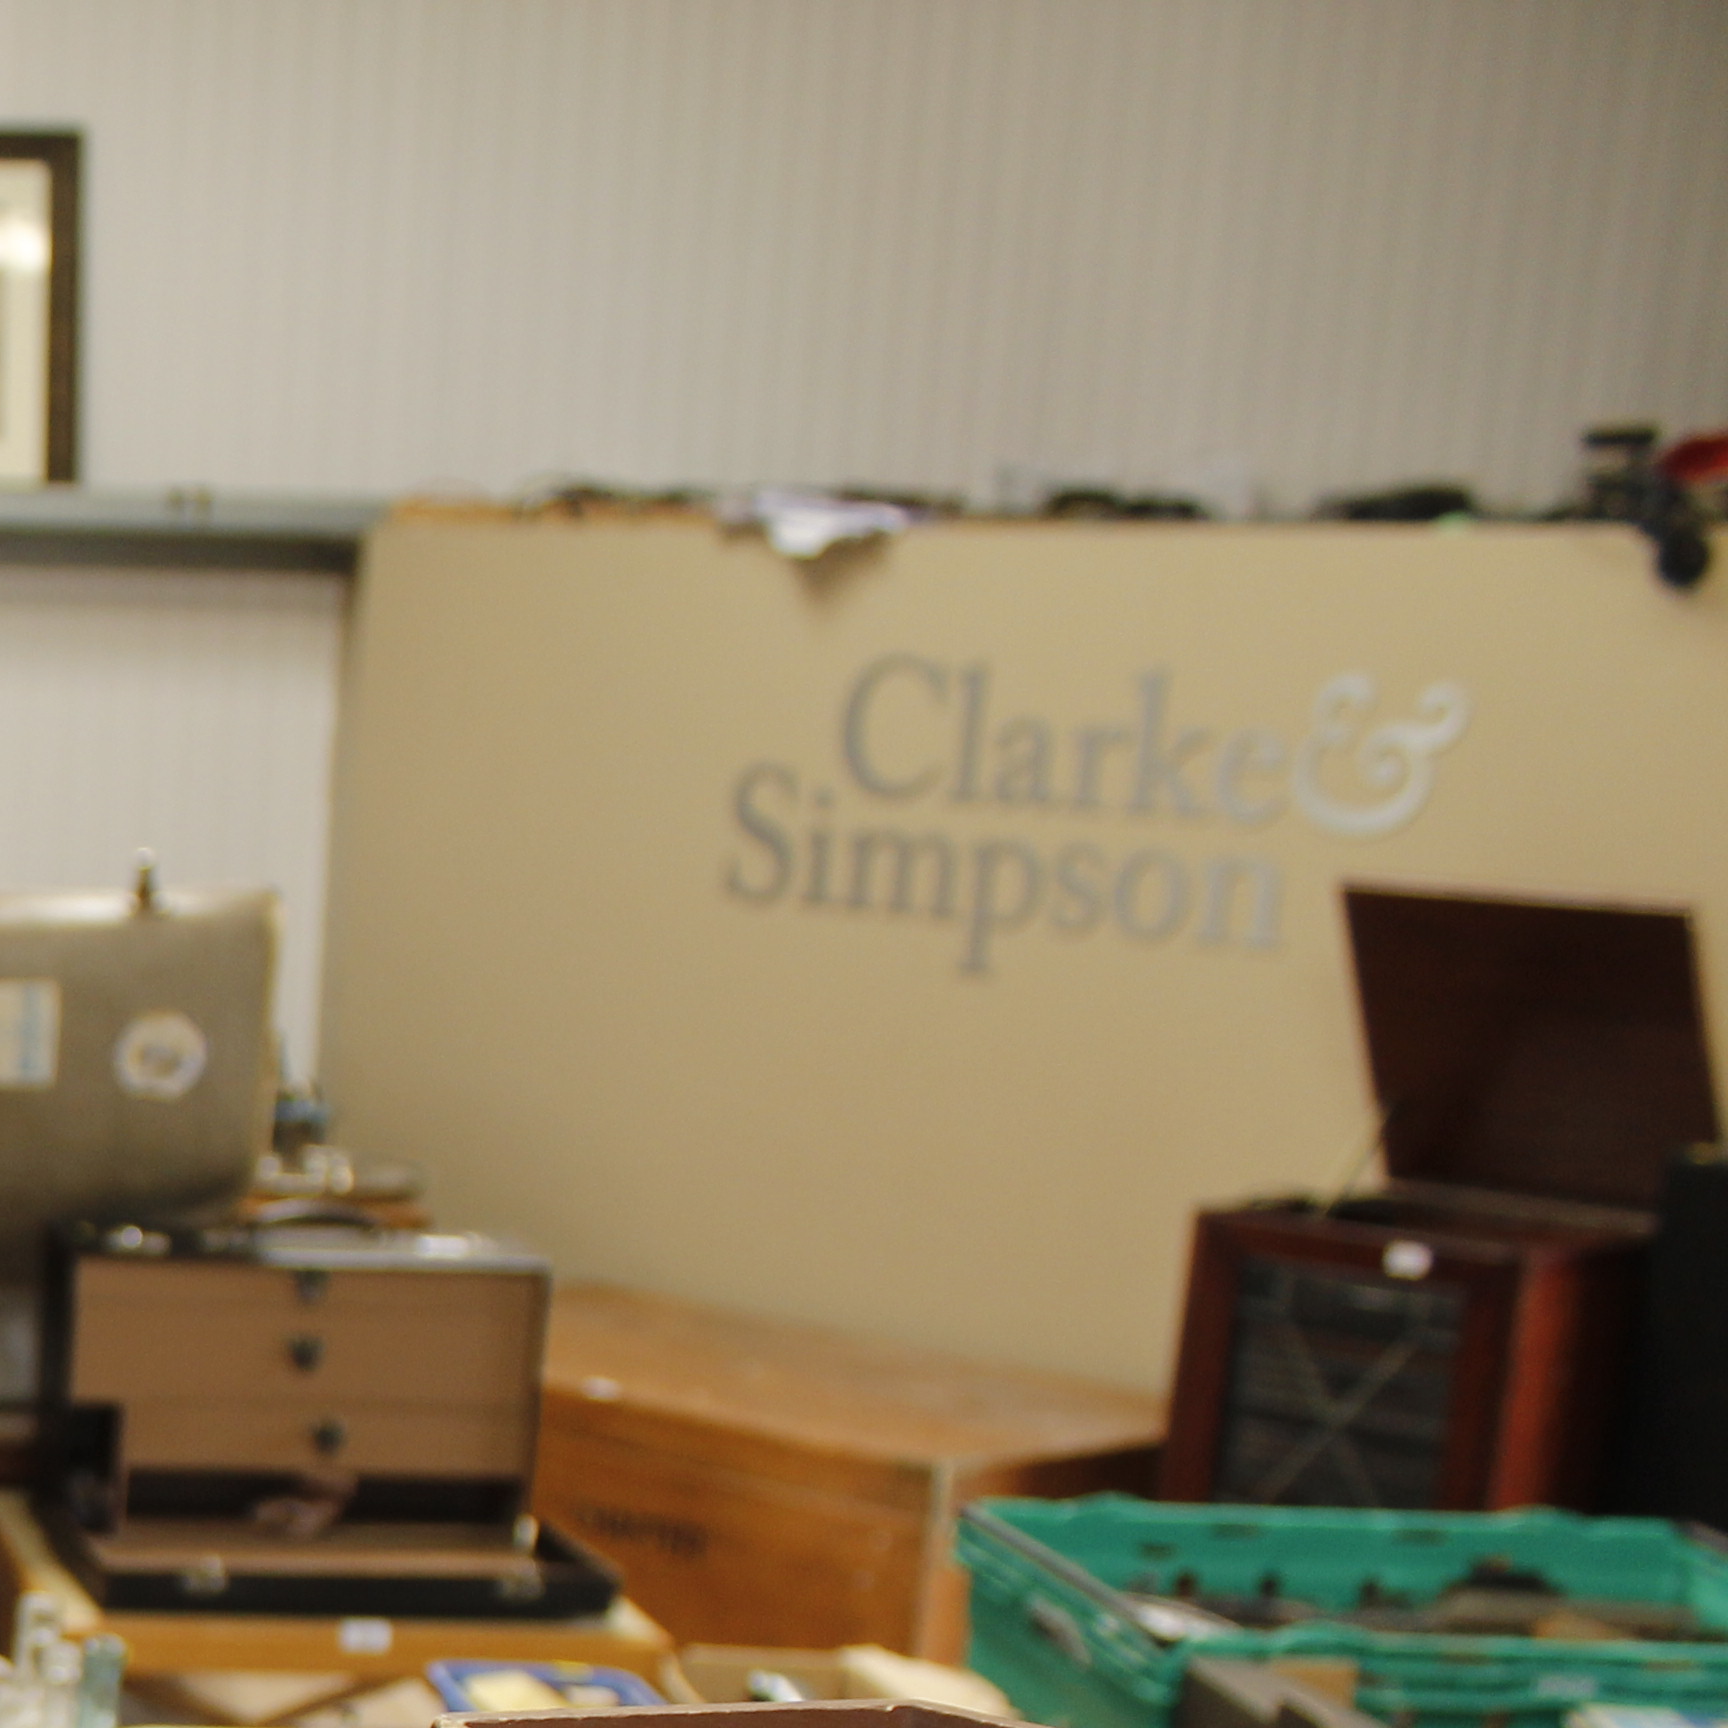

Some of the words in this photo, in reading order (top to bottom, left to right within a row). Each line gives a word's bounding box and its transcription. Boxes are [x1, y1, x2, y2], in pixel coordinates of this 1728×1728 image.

[841, 648, 1287, 828] Clarke
[1291, 669, 1474, 839] &
[725, 761, 1285, 979] Simpson
